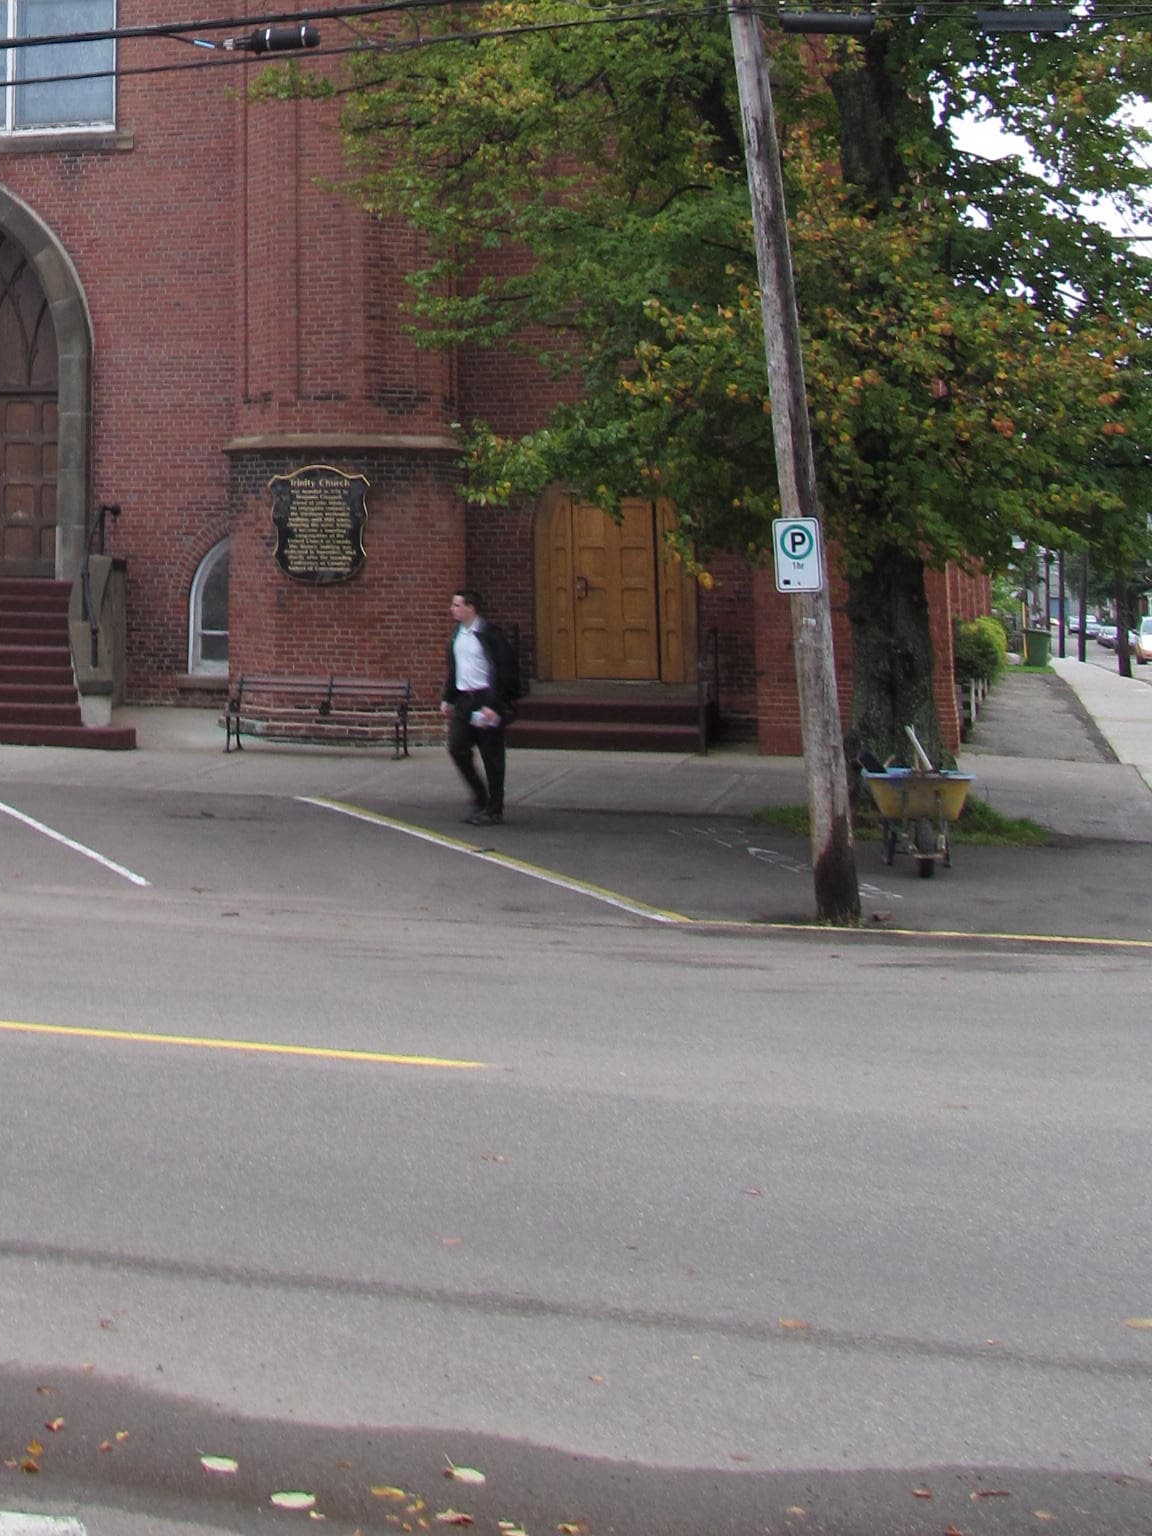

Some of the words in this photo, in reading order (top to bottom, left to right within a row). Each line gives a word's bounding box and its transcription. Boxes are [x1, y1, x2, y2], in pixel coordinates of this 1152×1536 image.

[290, 478, 315, 488] Trinity
[319, 478, 351, 487] Church
[790, 532, 806, 553] P
